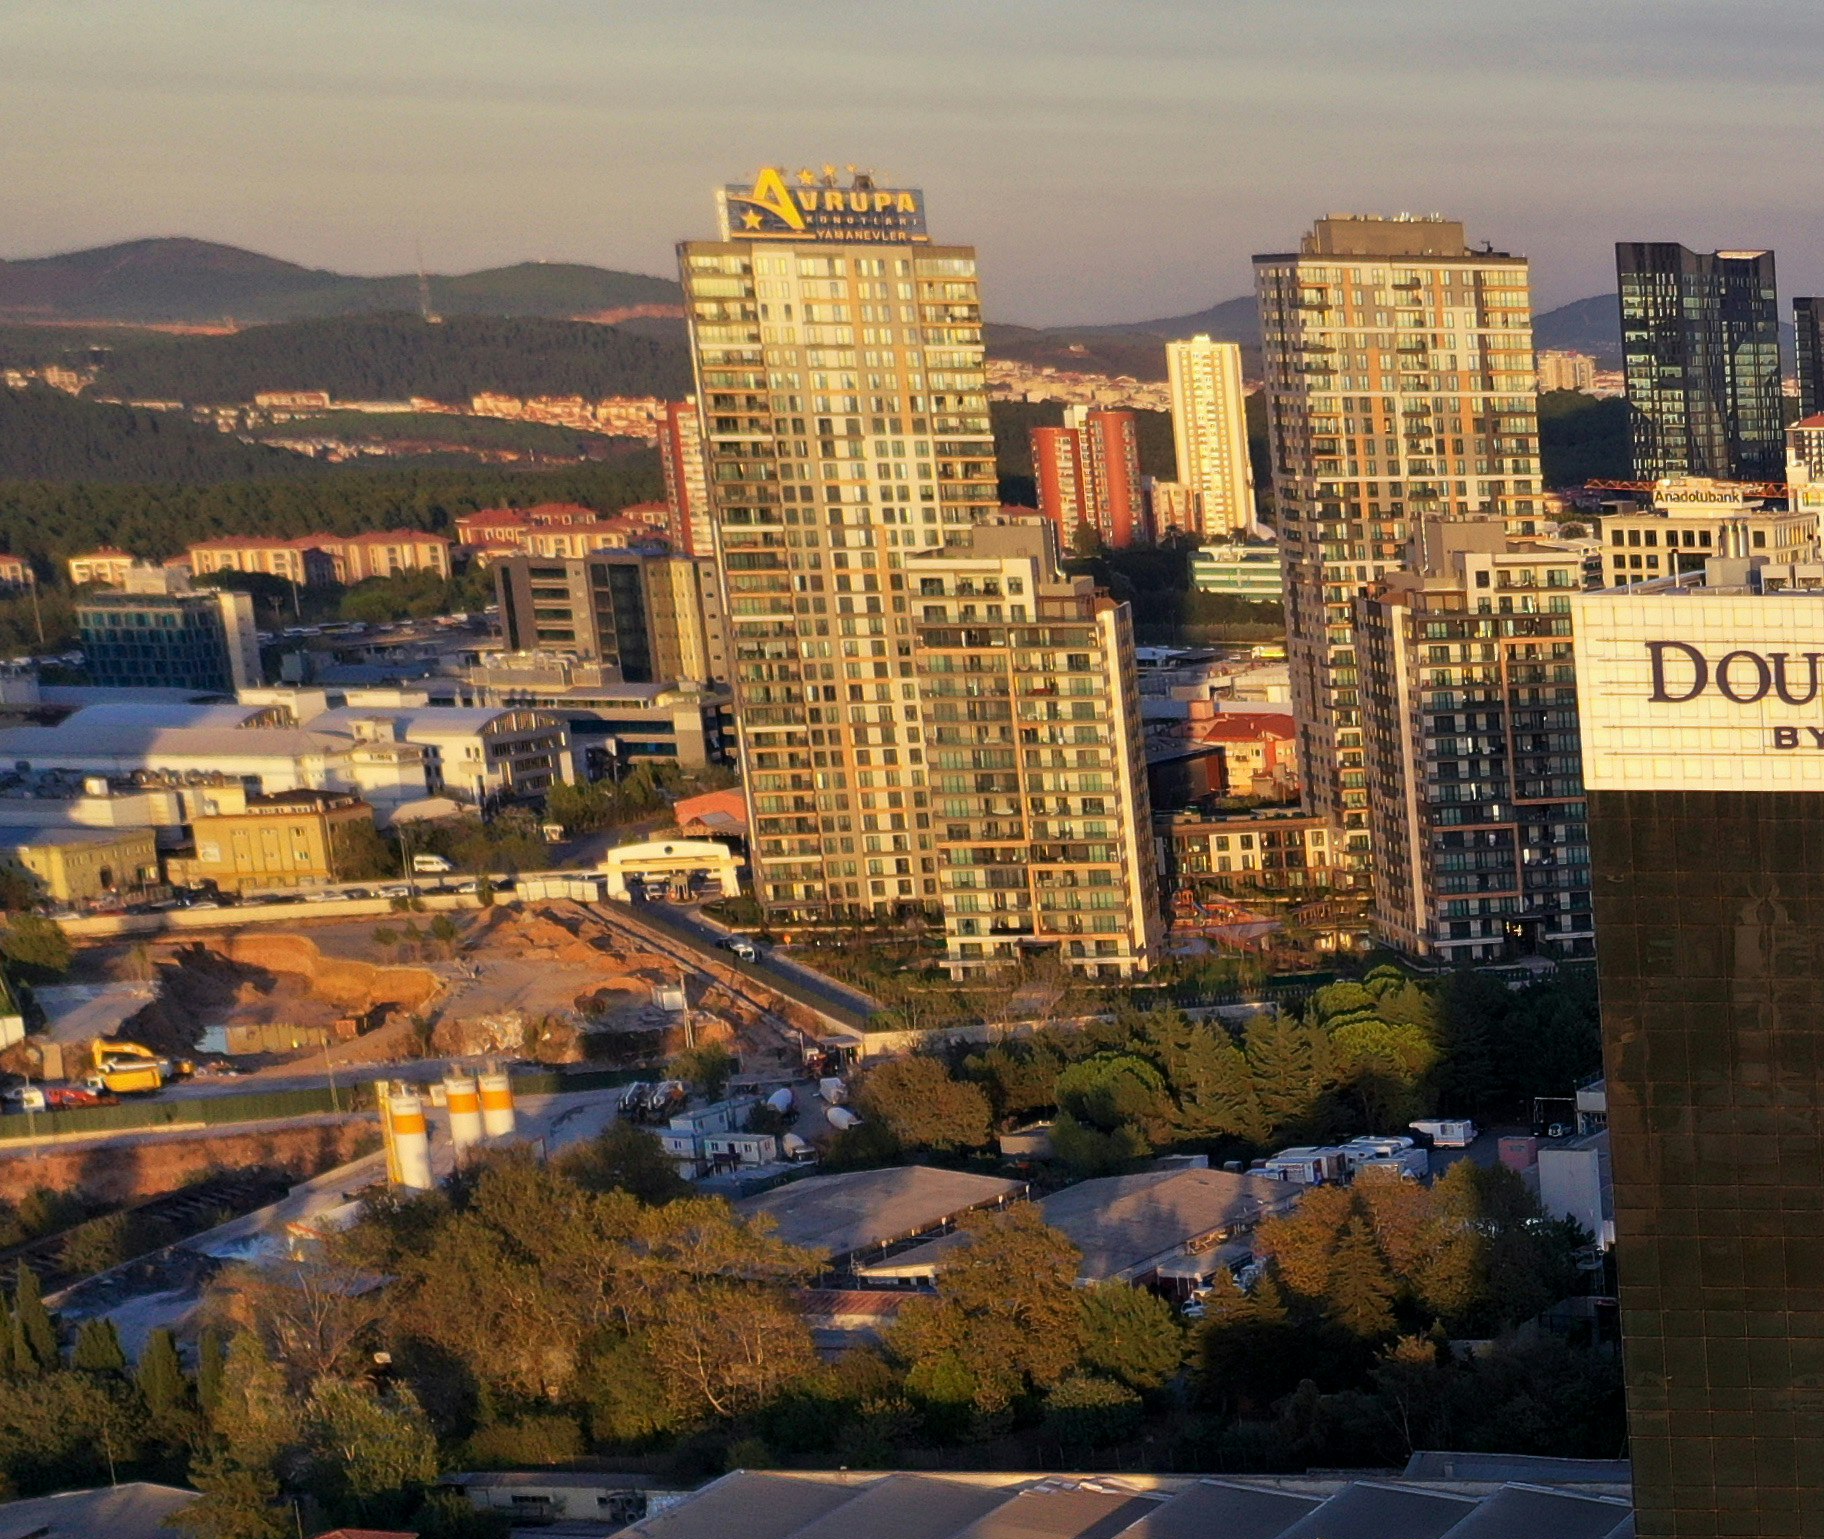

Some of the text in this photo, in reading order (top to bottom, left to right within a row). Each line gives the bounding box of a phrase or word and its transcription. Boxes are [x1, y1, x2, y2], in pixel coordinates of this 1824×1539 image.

[729, 168, 917, 230] AVRUPA
[816, 229, 907, 242] YAMANEVLER
[1654, 489, 1741, 503] Anadolubank
